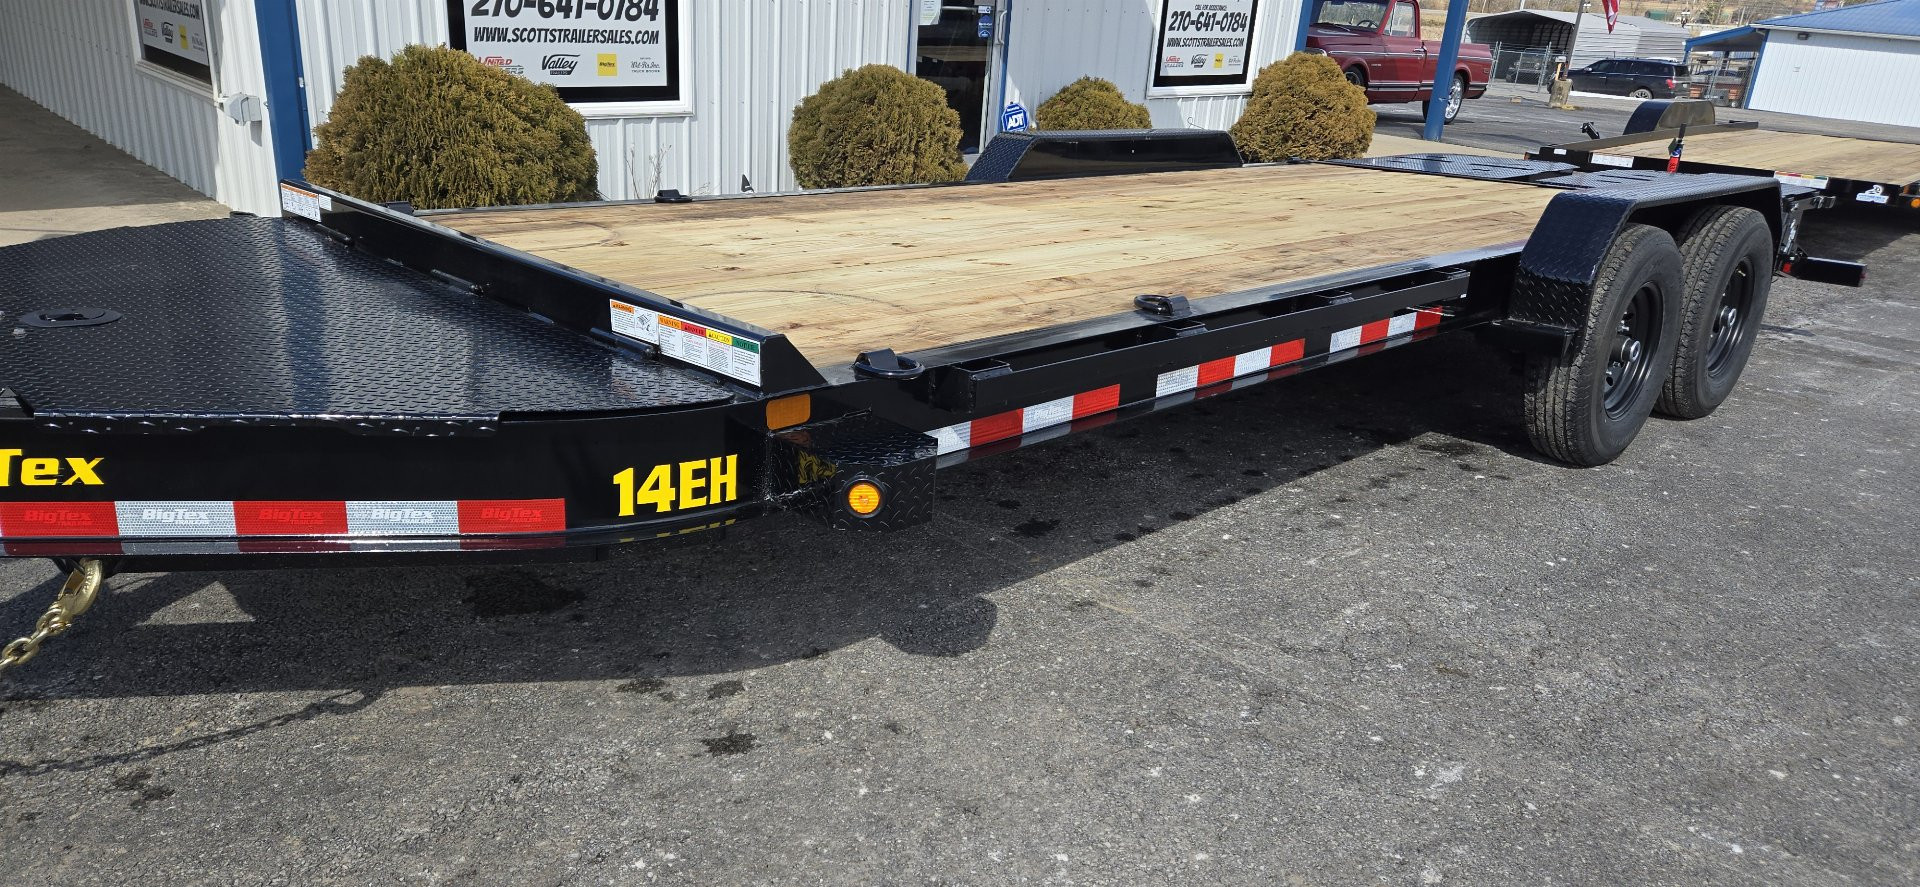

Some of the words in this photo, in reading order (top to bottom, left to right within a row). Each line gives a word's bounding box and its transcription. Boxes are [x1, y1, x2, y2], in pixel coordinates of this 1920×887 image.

[1169, 11, 1248, 32] 270-641-0784
[473, 27, 659, 45] WWW.SCOTTSTRAILERSALES.COM
[541, 54, 581, 71] Valley
[1007, 113, 1024, 126] ADT
[613, 454, 738, 516] 14EH
[142, 508, 209, 523] BigTex
